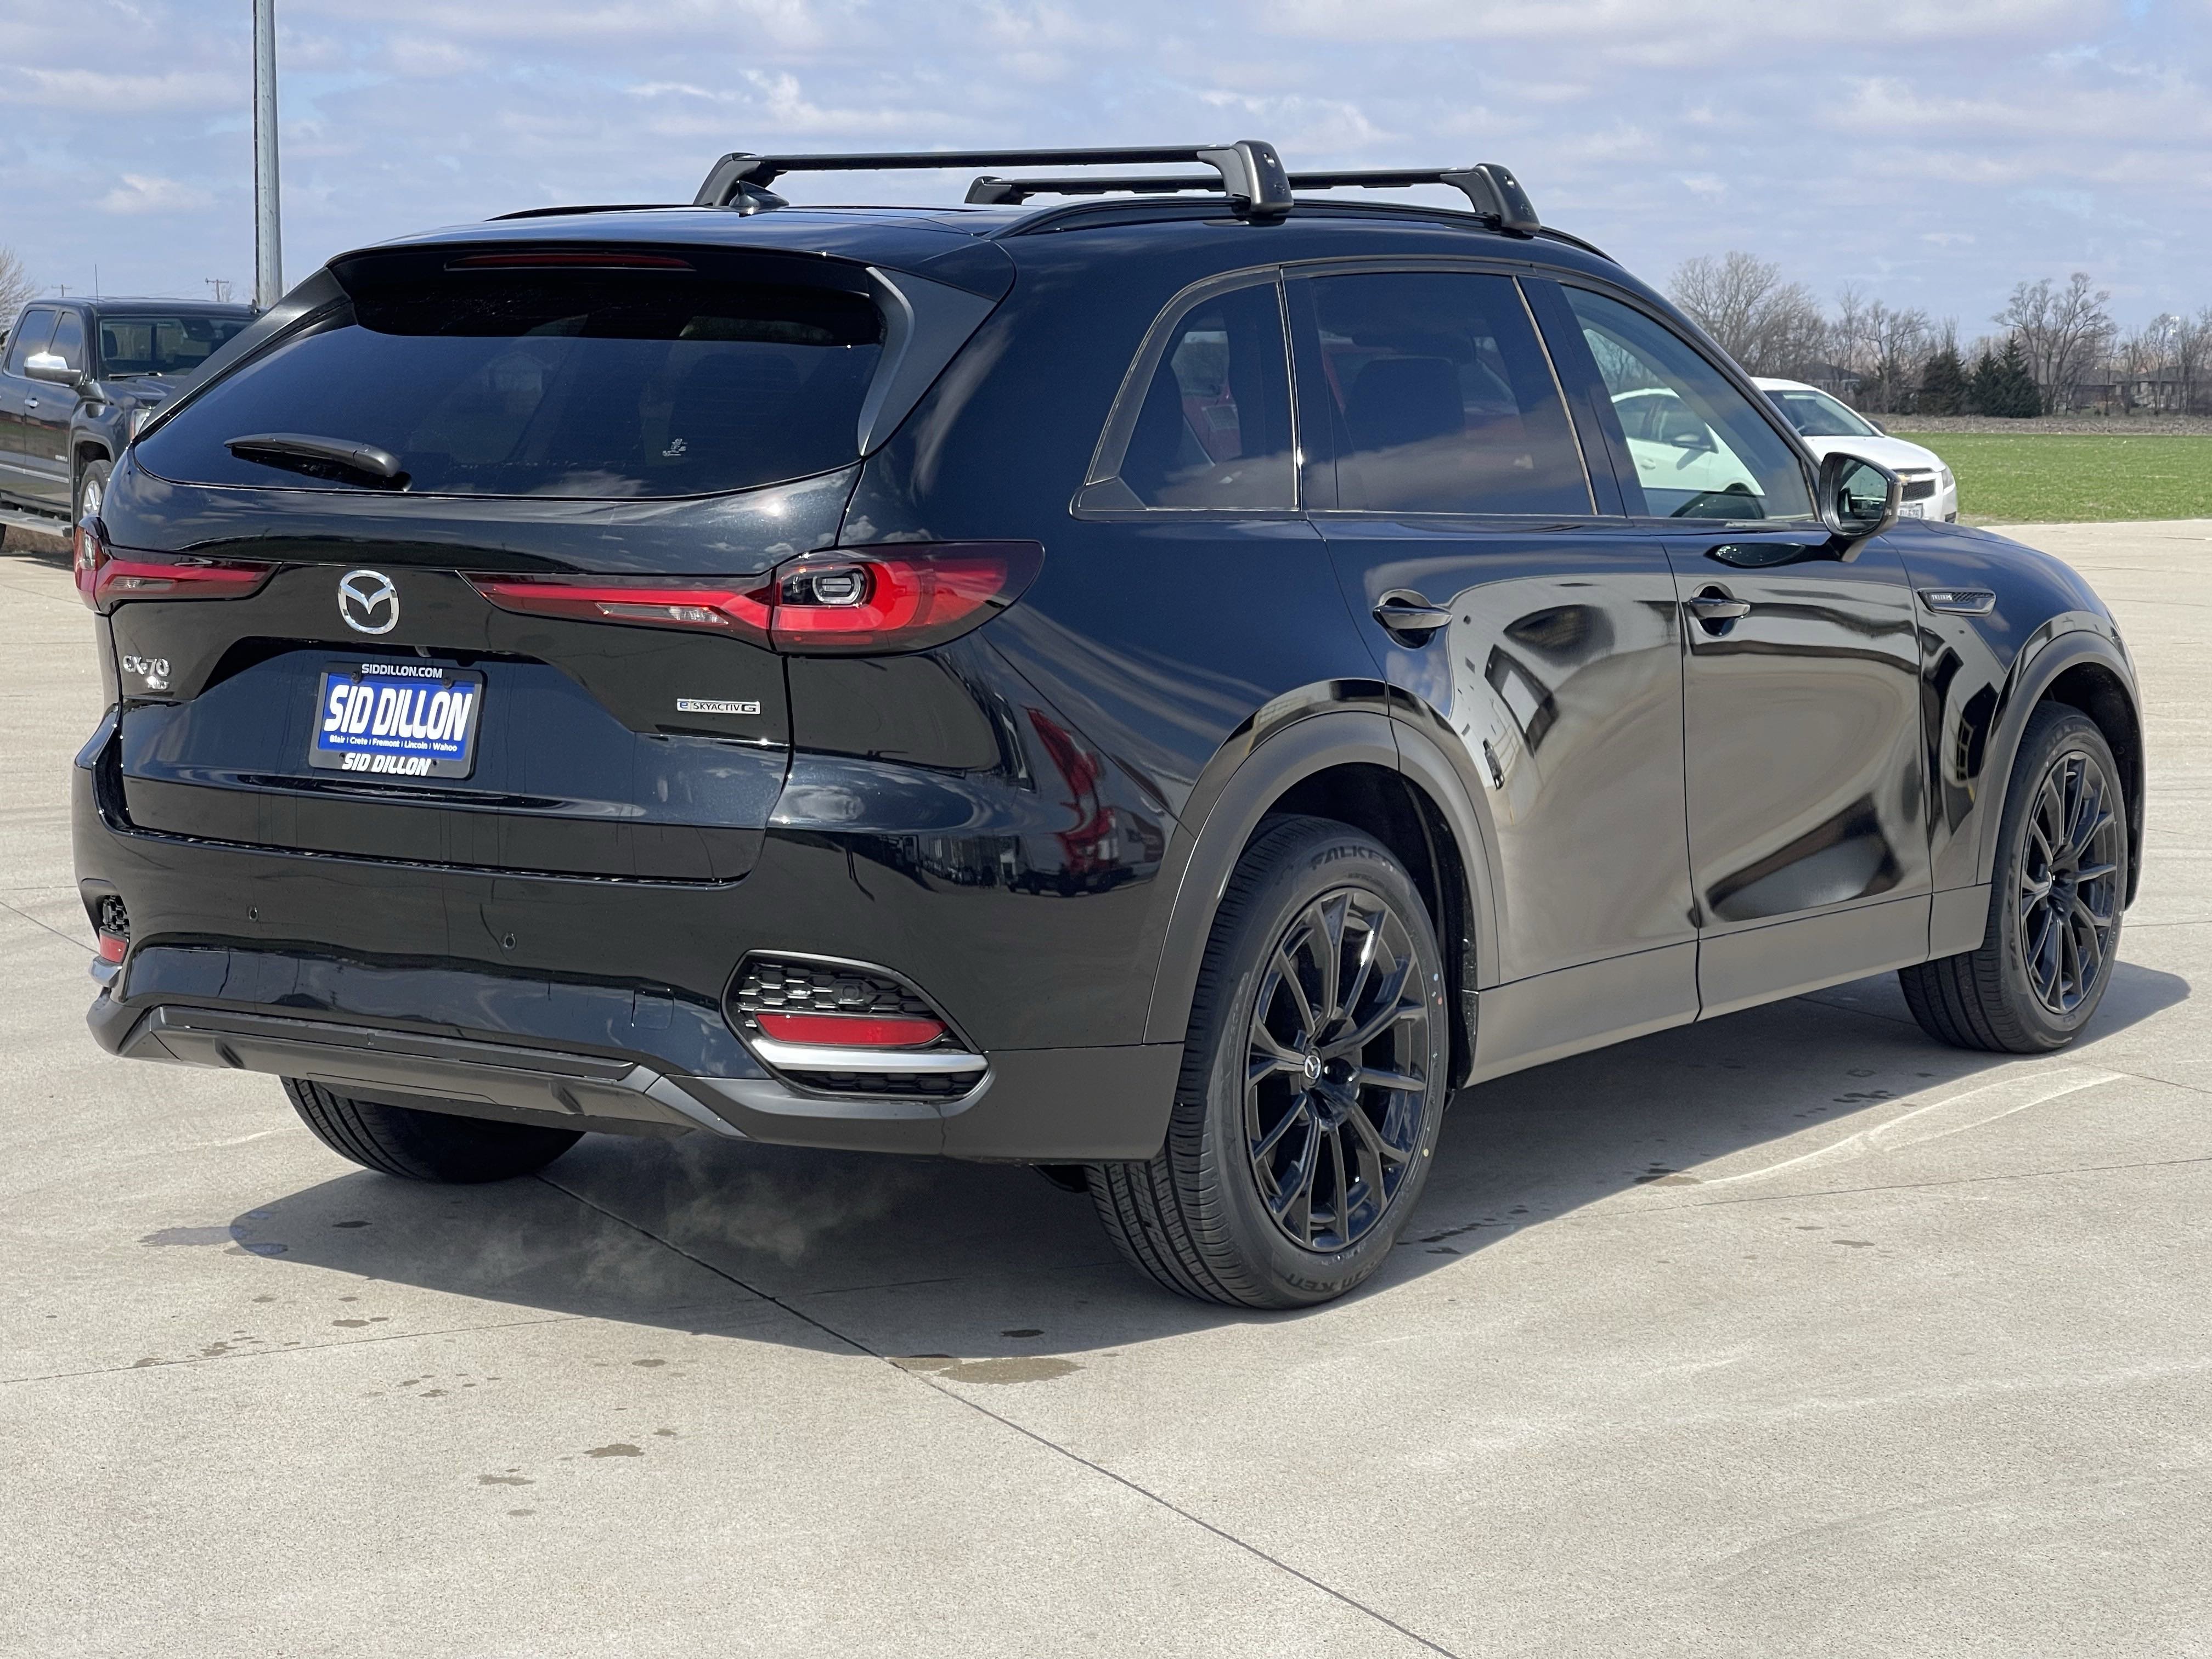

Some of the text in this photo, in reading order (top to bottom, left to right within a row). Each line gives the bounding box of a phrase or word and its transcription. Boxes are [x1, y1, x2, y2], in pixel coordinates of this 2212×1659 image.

[123, 655, 170, 676] CX-70
[362, 664, 443, 678] SIDDILLON.COM
[324, 684, 473, 741] SID DILLON
[329, 735, 458, 752] Blair Crete Fremont Lincoln Wahoo
[342, 753, 431, 776] SID DILLON
